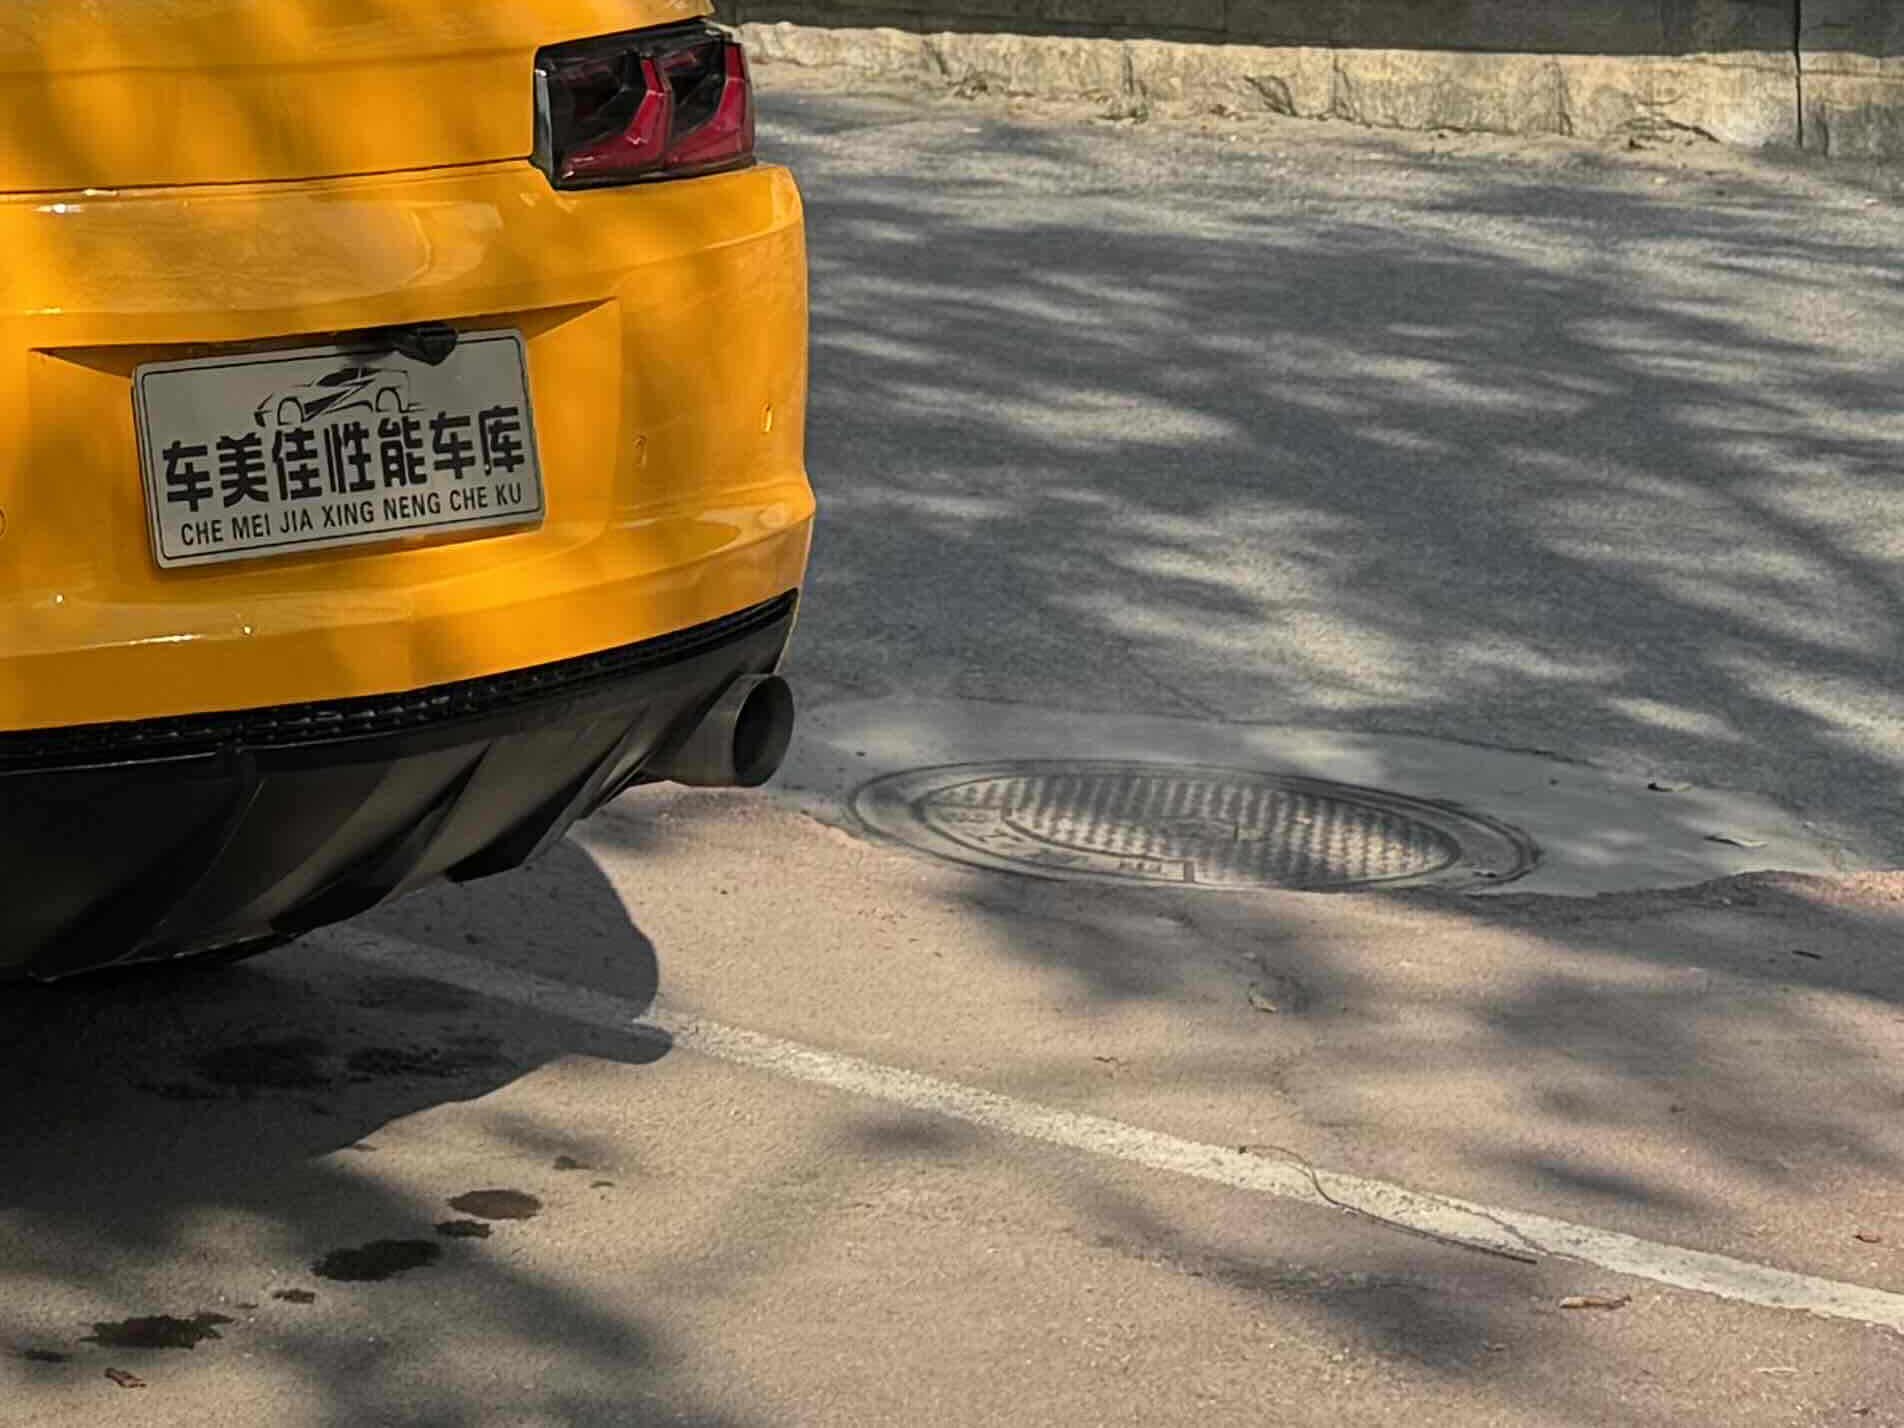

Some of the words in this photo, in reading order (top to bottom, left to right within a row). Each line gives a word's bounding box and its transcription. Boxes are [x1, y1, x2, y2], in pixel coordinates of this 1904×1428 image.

[163, 405, 525, 512] 车美佳性能车库
[181, 519, 223, 546] CHE
[232, 512, 270, 540] MEI
[280, 508, 313, 533] JIA
[321, 501, 374, 529] XING
[383, 492, 441, 520] NENG
[449, 486, 488, 512] CHE
[495, 483, 521, 506] KU
